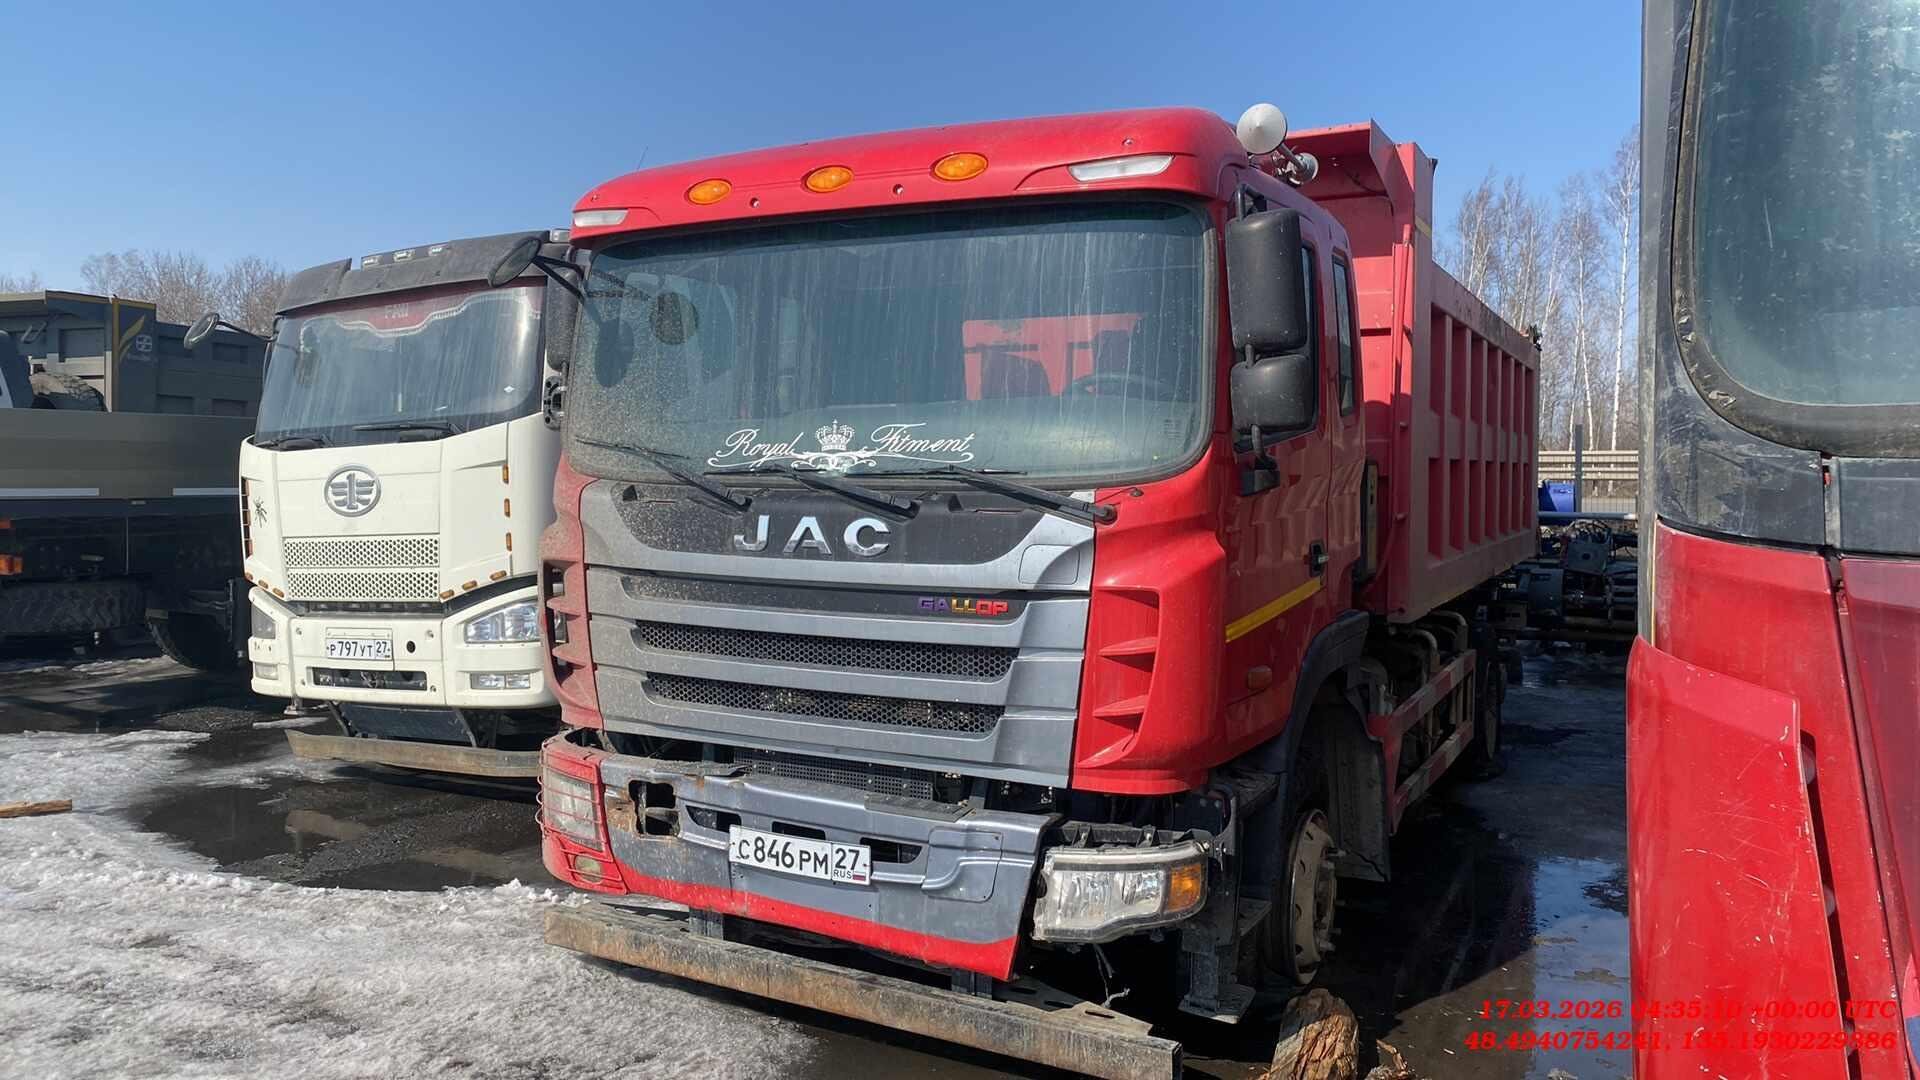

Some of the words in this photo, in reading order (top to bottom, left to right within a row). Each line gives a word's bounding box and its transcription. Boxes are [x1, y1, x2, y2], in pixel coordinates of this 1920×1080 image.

[715, 428, 804, 471] Royal
[870, 422, 976, 453] Fitment
[733, 515, 890, 557] JAC
[918, 597, 1009, 617] GALLOP
[834, 847, 861, 871] 27
[833, 869, 852, 880] RUS
